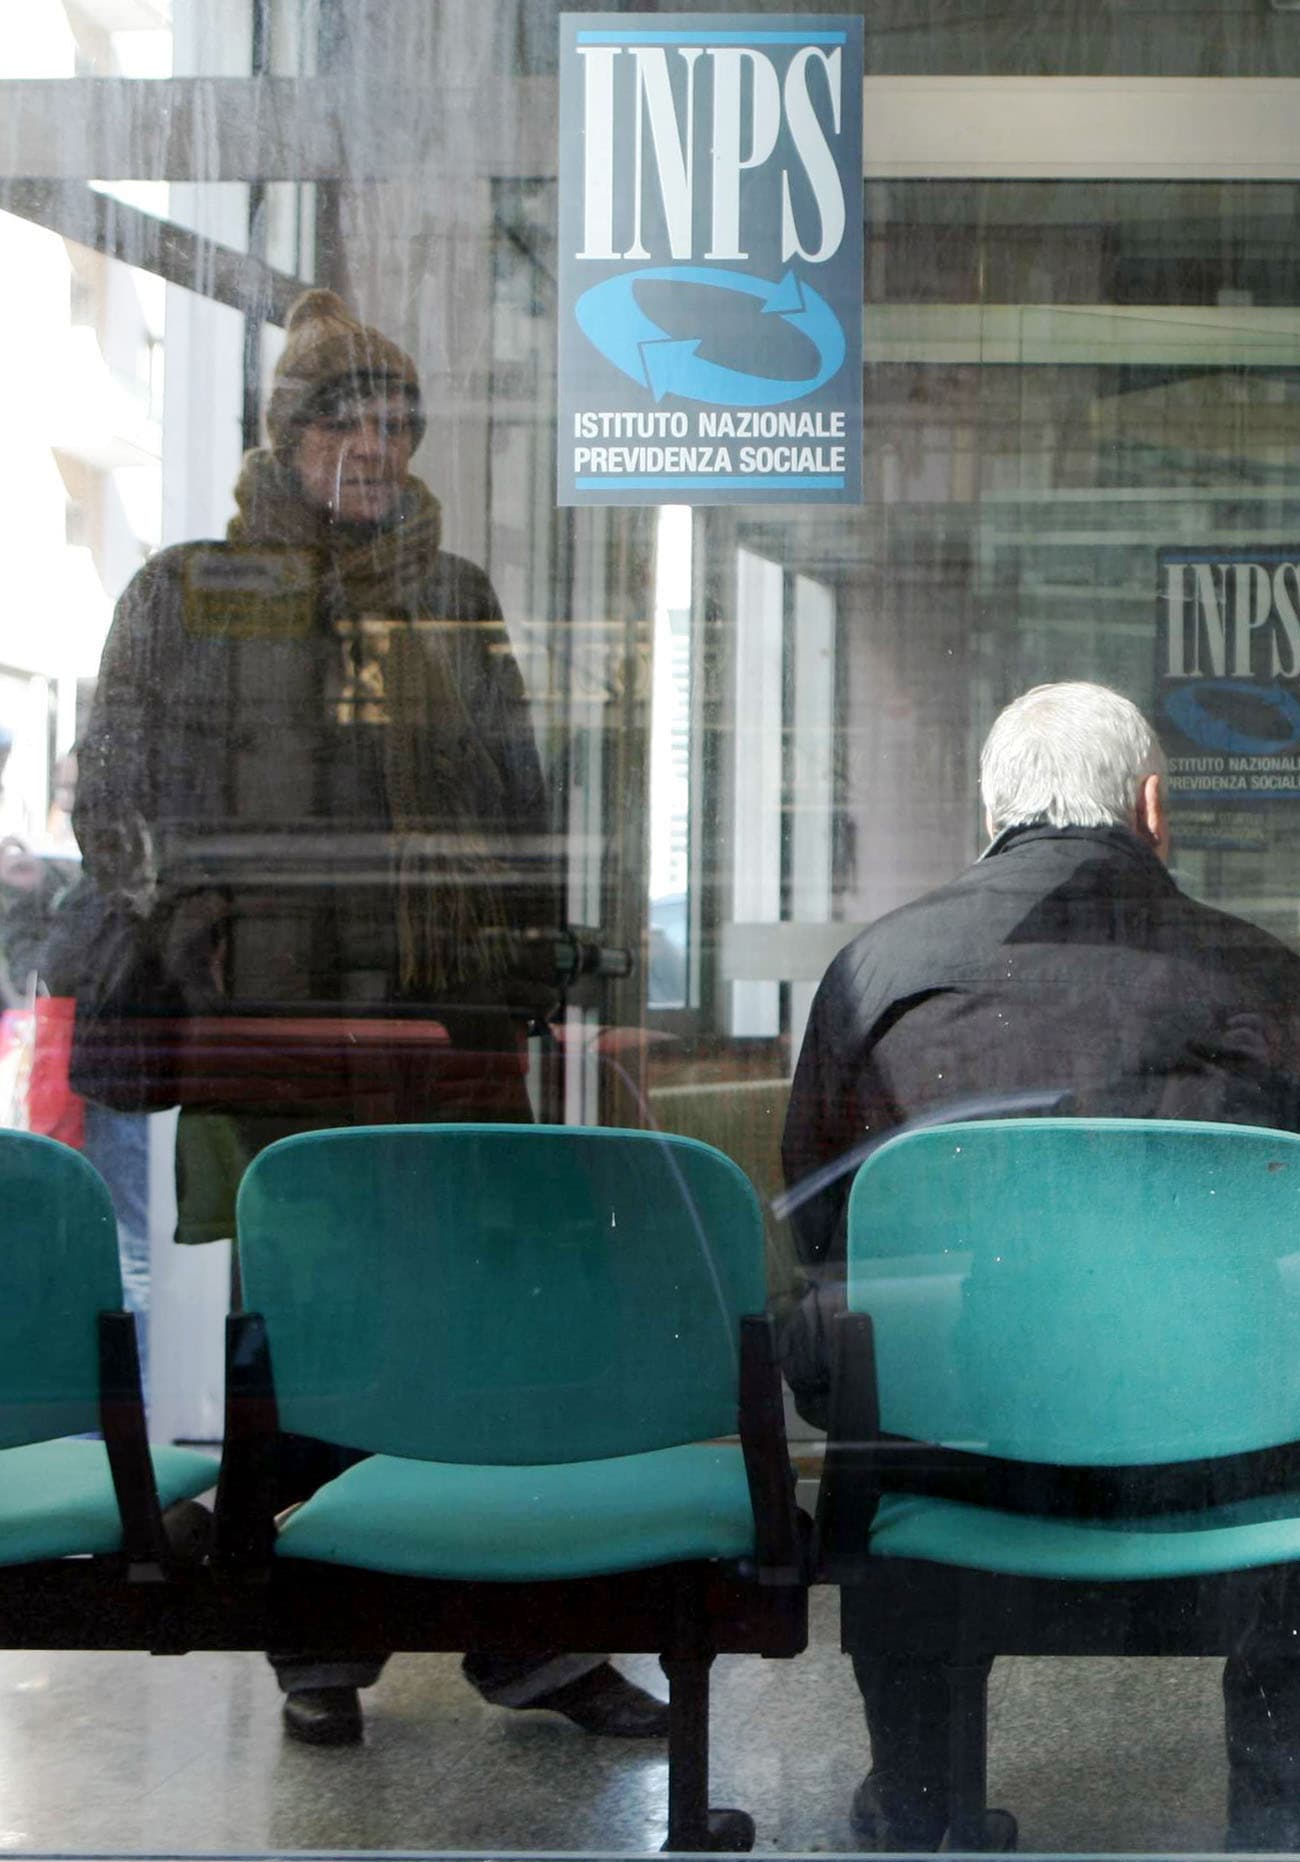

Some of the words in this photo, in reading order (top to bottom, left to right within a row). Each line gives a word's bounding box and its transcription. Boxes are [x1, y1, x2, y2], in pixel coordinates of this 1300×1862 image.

[575, 46, 846, 263] INPS
[574, 411, 689, 438] ISTITUTO
[699, 411, 846, 438] NAZIONALE
[574, 446, 733, 473] PREVIDENZA
[739, 446, 846, 473] SOCIALE
[1168, 757, 1225, 772] STITUTO
